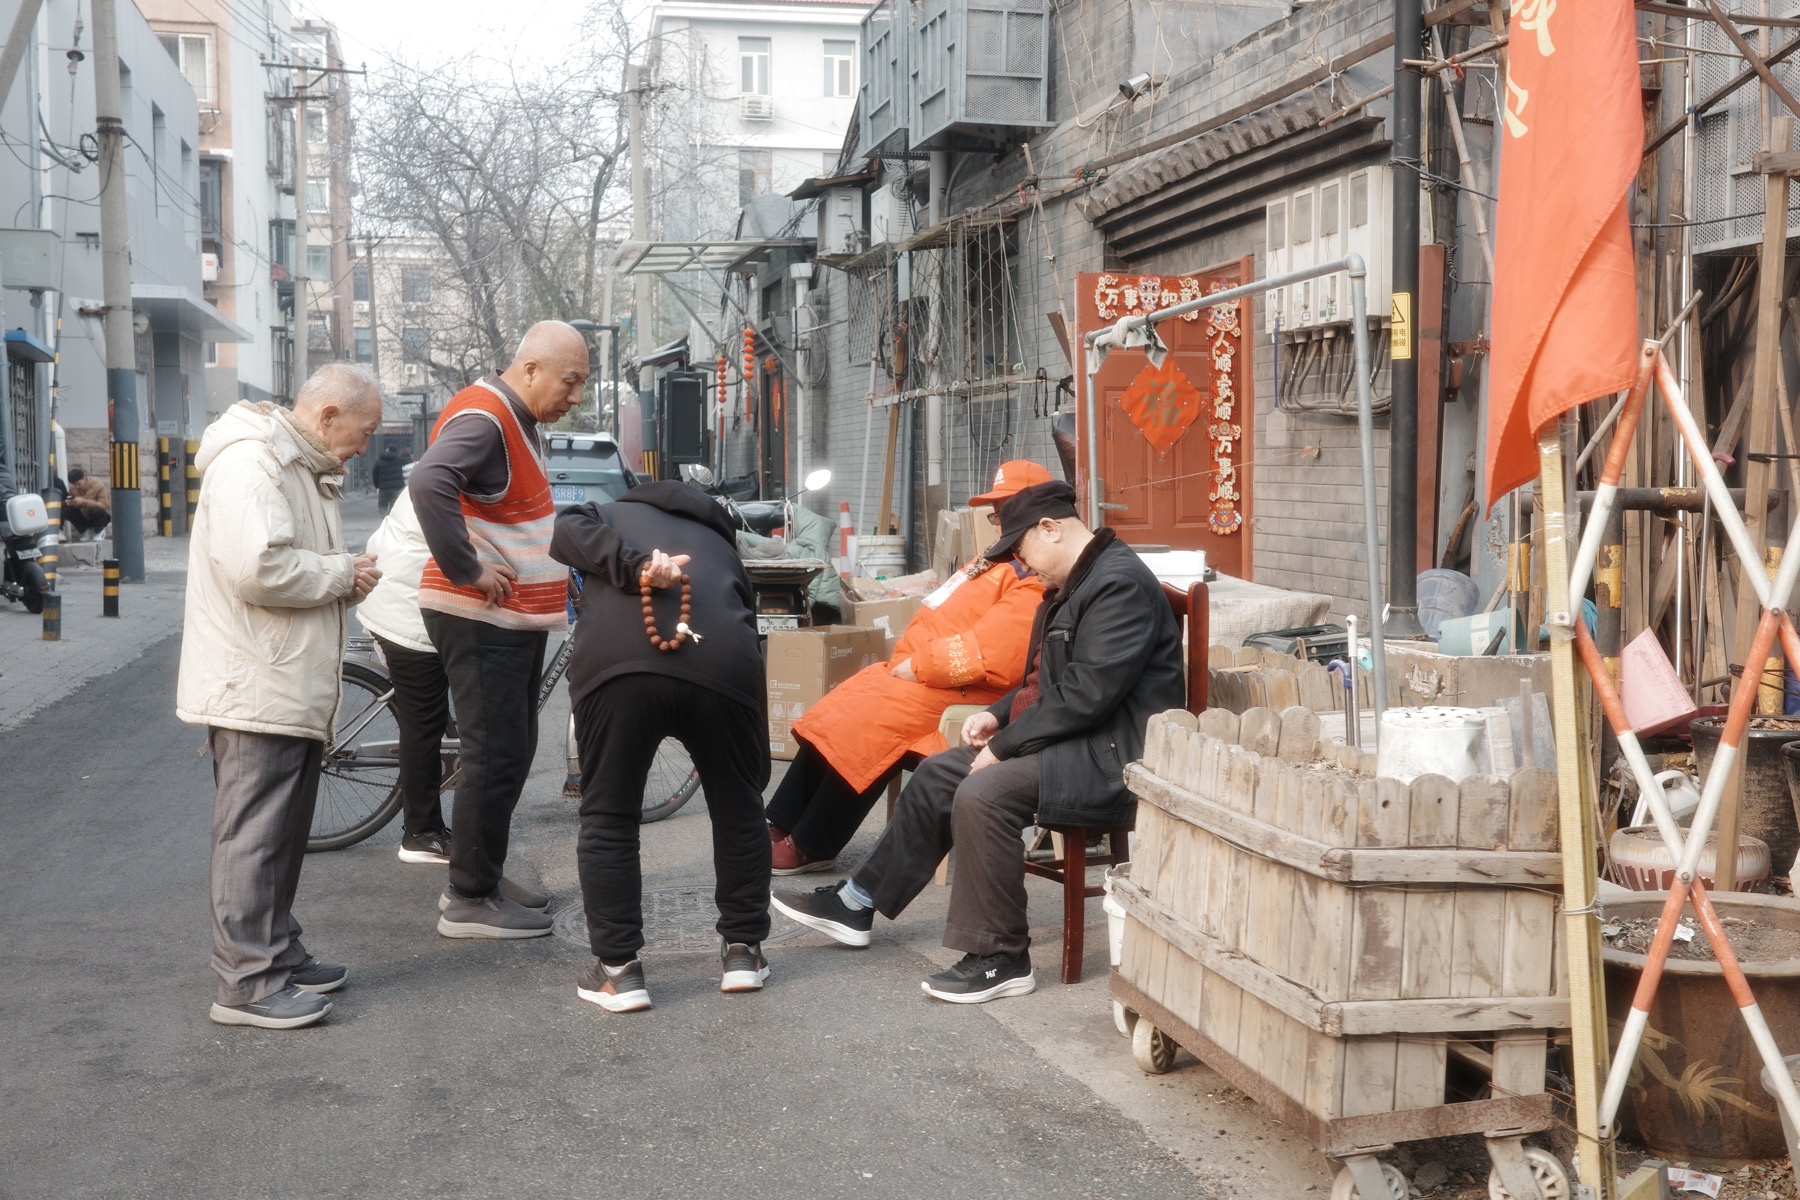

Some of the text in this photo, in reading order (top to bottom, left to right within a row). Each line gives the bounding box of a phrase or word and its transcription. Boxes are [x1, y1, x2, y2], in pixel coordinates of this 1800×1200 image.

[1105, 287, 1193, 309] 万事如意
[1141, 379, 1181, 426] 福
